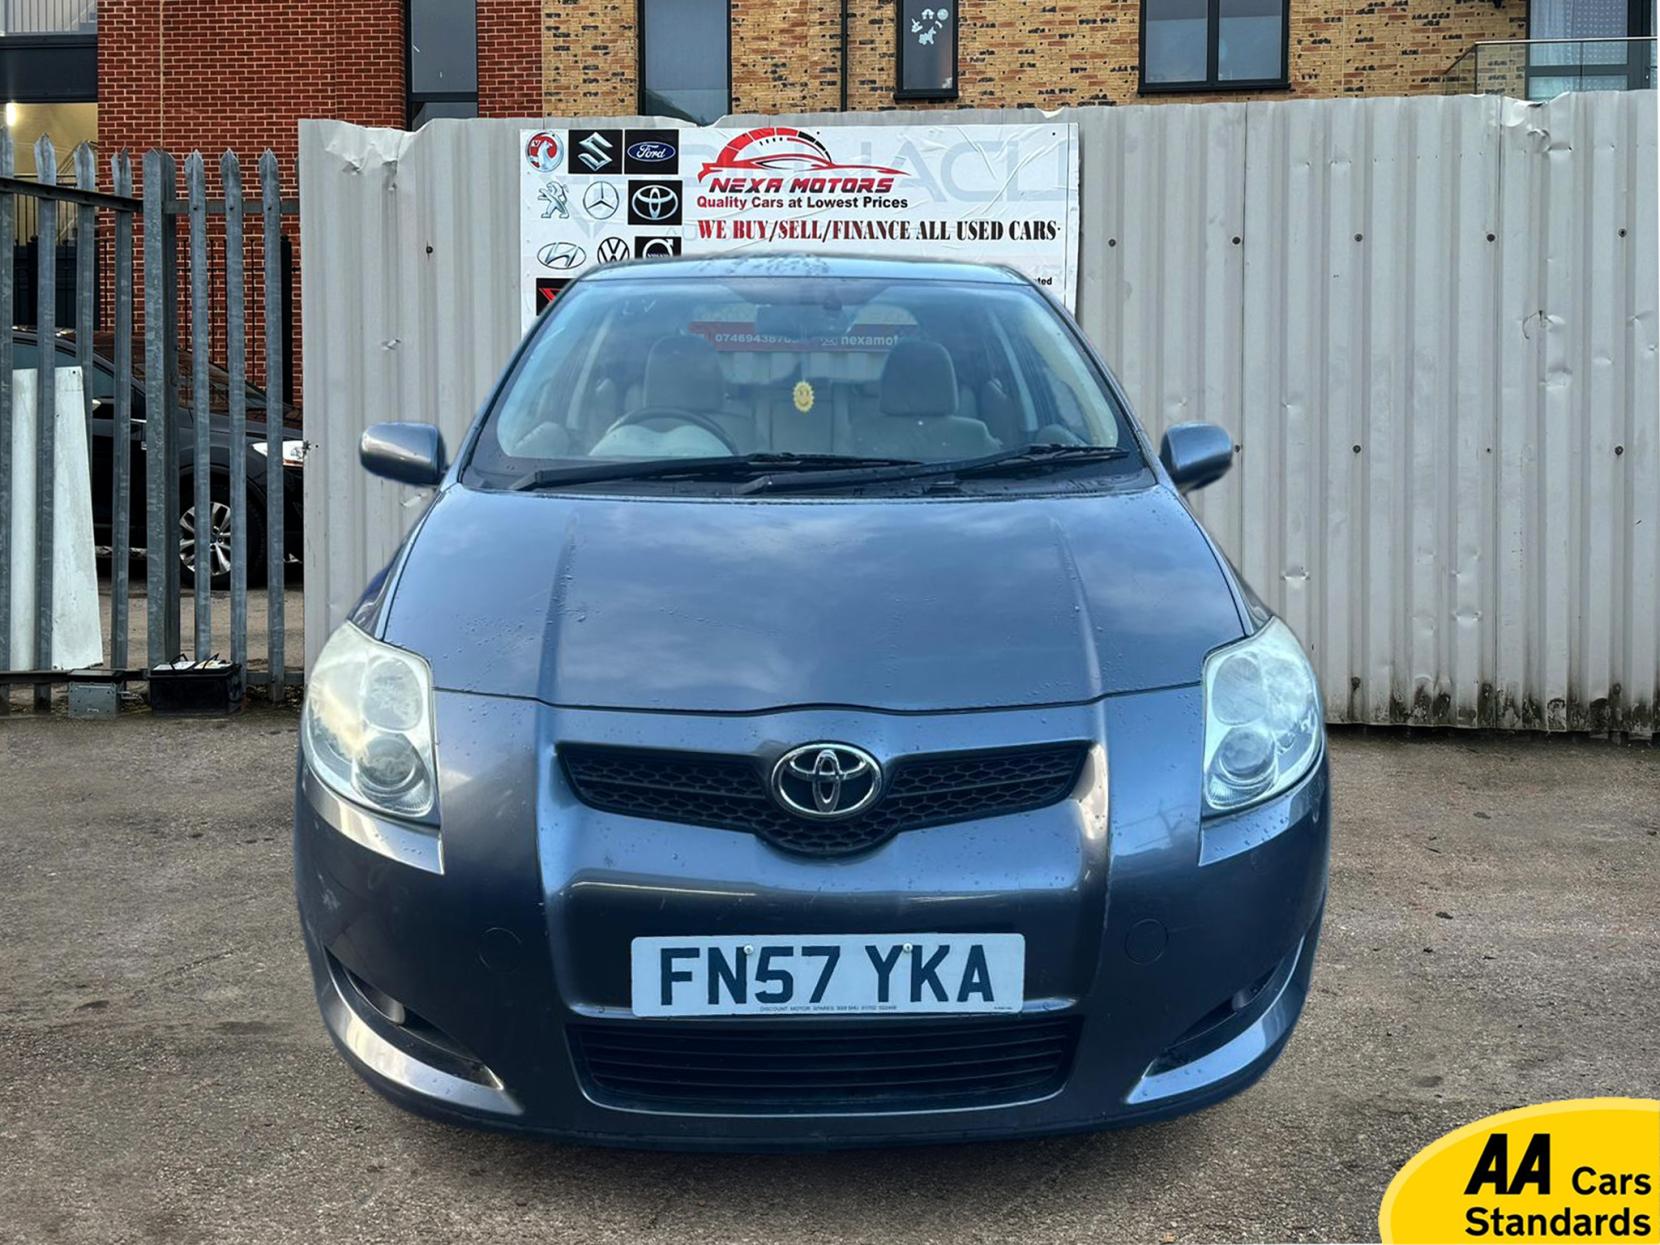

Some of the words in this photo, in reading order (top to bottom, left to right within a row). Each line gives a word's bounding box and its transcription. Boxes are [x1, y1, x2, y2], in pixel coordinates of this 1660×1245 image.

[636, 144, 666, 158] Ford
[709, 178, 784, 193] NEXA
[789, 178, 894, 193] MOTORS
[697, 196, 747, 210] Quality
[752, 196, 784, 208] Cars
[788, 196, 803, 208] at
[807, 196, 858, 208] Lowest
[863, 196, 908, 208] Prices
[698, 220, 726, 240] WE
[733, 220, 911, 242] BUY/SELL/FINANCE
[916, 221, 950, 240] ALL
[957, 221, 1003, 240] USED
[1009, 221, 1057, 240] CARS
[660, 946, 841, 1005] FN57
[864, 944, 994, 1003] YKA
